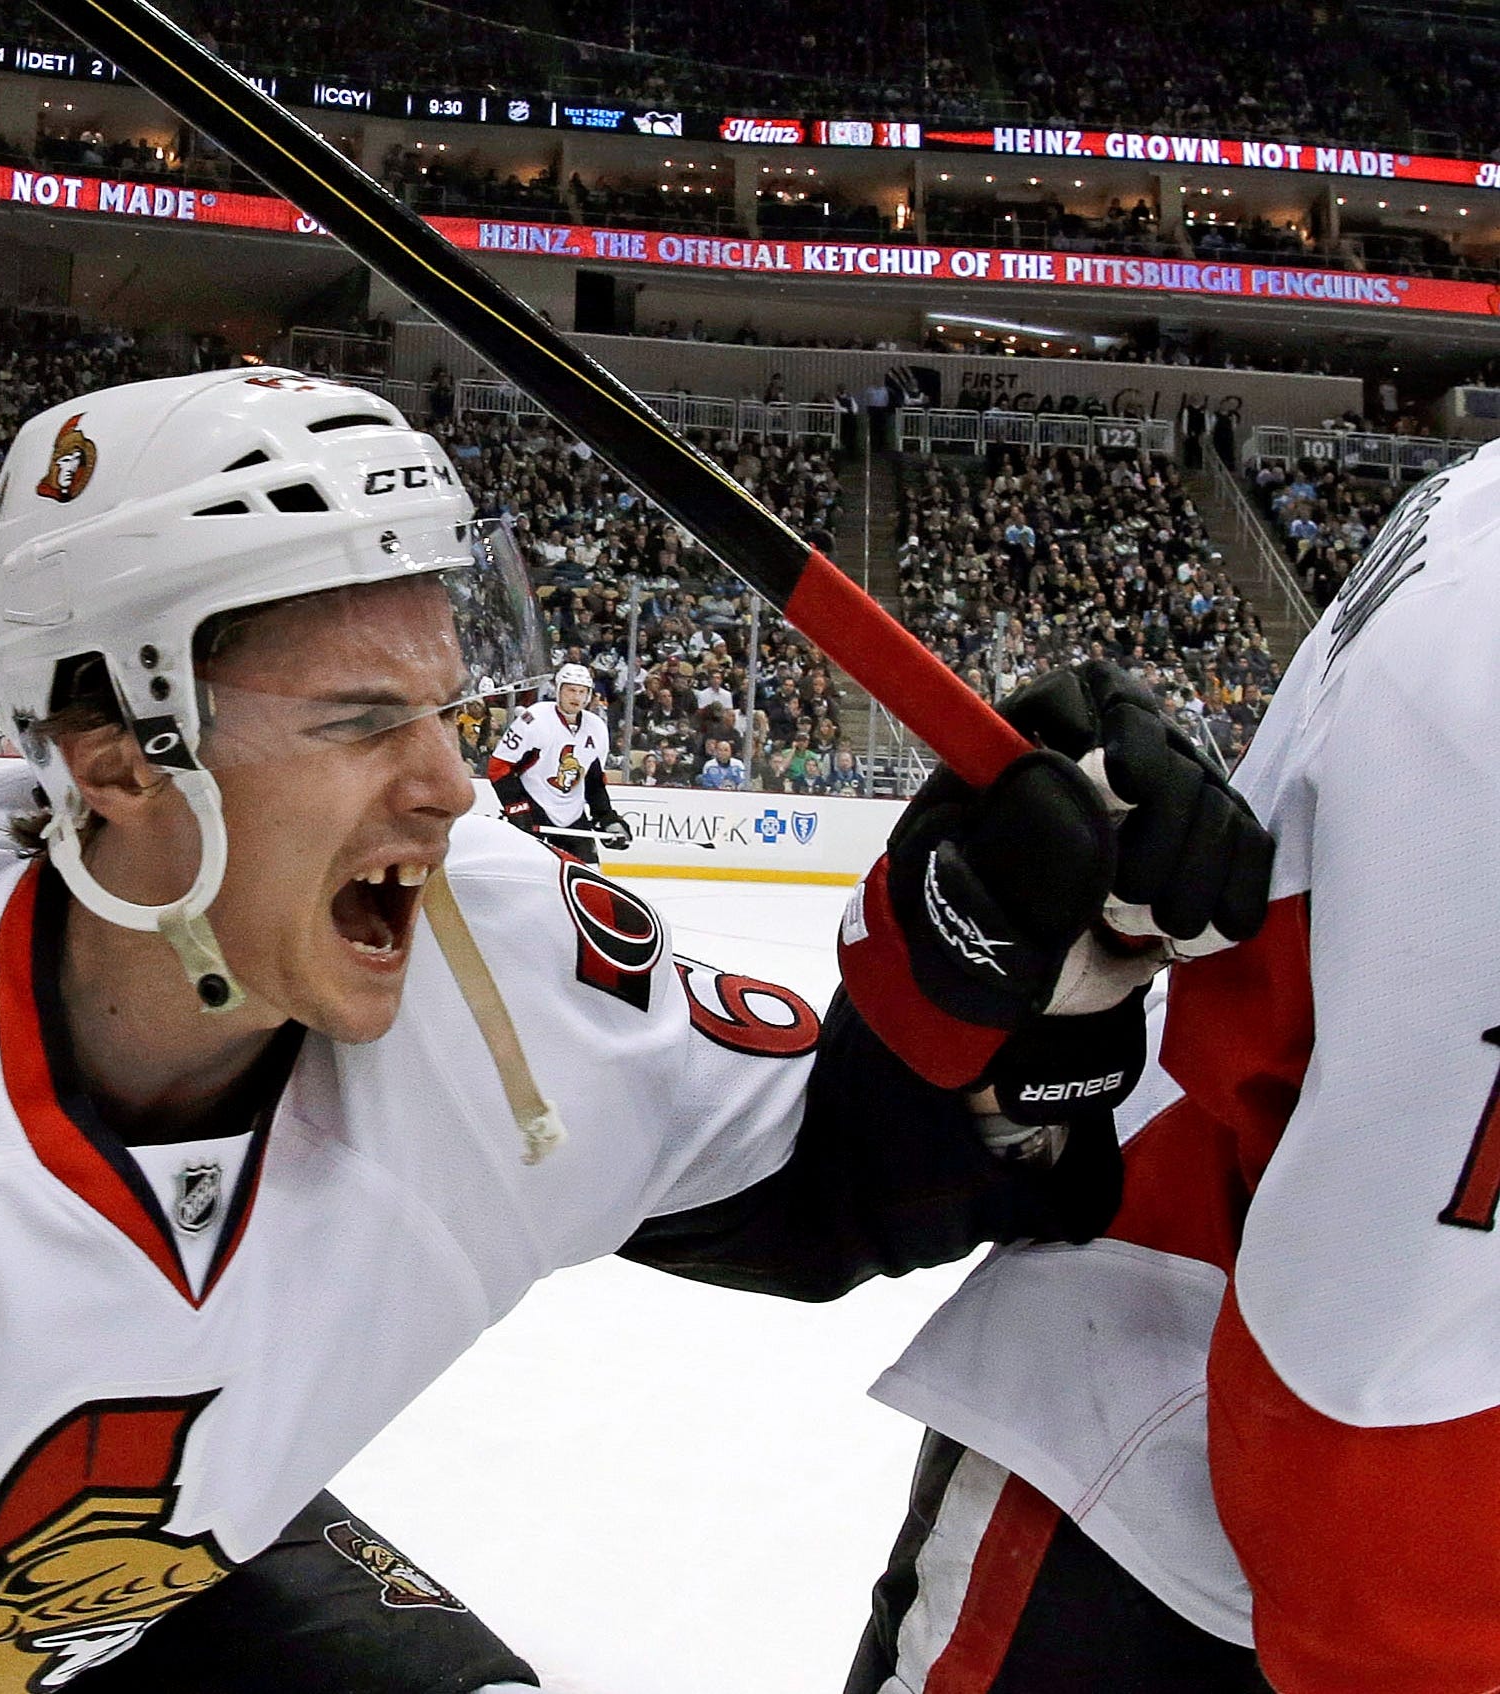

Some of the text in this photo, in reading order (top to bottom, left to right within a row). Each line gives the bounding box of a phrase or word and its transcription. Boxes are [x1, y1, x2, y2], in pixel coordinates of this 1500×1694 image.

[28, 54, 67, 72] DET
[91, 60, 102, 76] 2
[325, 86, 367, 107] CGY
[428, 98, 463, 116] 9:30
[723, 118, 799, 145] Heinz
[993, 126, 1093, 156] HEINZ.
[1105, 132, 1230, 165] GROWN.
[1242, 142, 1302, 170] NOT
[11, 170, 83, 208] NOT
[478, 223, 581, 256] HEINZ.
[592, 230, 648, 260] THE
[658, 235, 793, 270] OFFICIAL
[803, 244, 942, 276] KETCHUP
[950, 250, 992, 278] OF
[999, 253, 1055, 281] THE
[1065, 256, 1242, 292] PITTSBURGH
[961, 371, 1019, 389] FIRST
[1100, 428, 1137, 447] 122
[1302, 439, 1335, 459] 101
[584, 735, 596, 749] A
